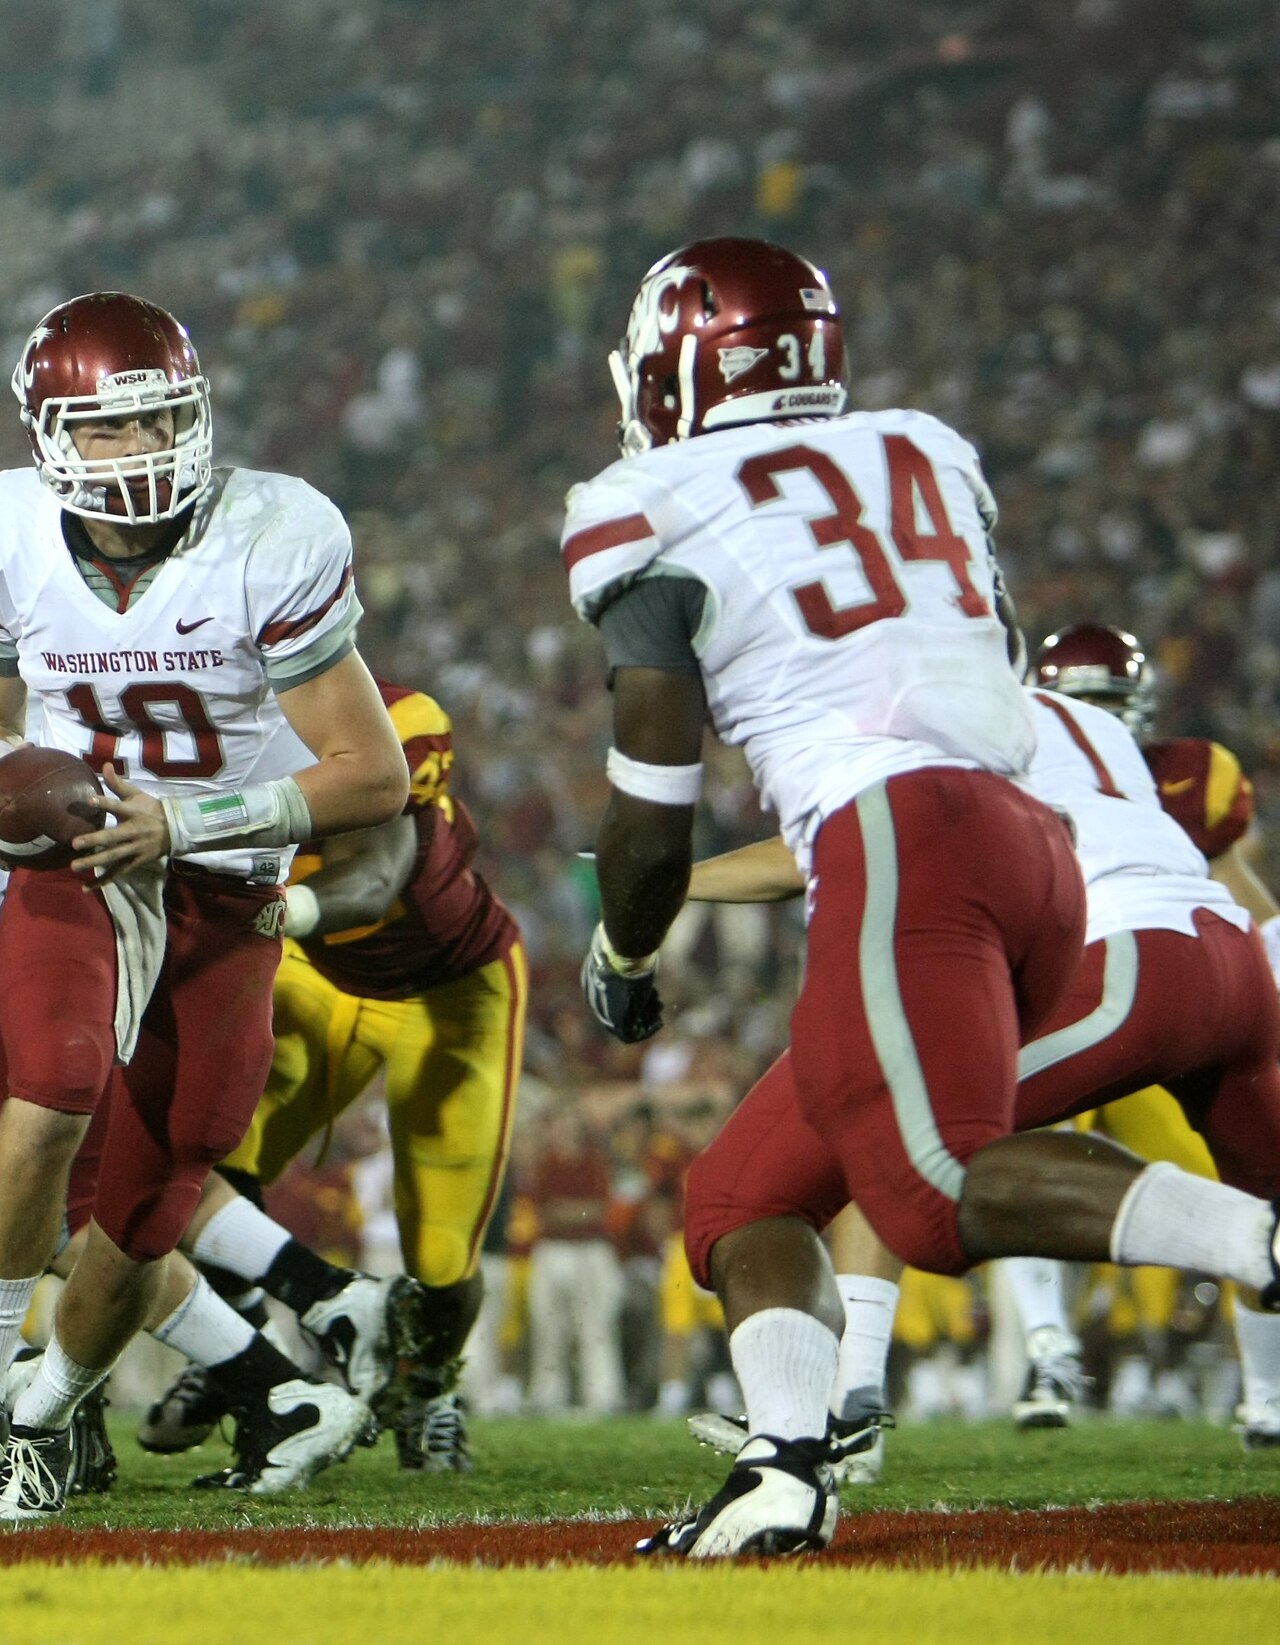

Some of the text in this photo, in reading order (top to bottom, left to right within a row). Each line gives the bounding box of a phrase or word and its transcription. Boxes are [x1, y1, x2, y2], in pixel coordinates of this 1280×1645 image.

[777, 330, 825, 380] 34
[114, 372, 147, 386] WSU
[788, 393, 830, 407] COUGARS
[733, 431, 992, 642] 34
[41, 650, 224, 674] WASHINGTON STATE
[62, 680, 227, 780] 10
[259, 862, 275, 873] 42
